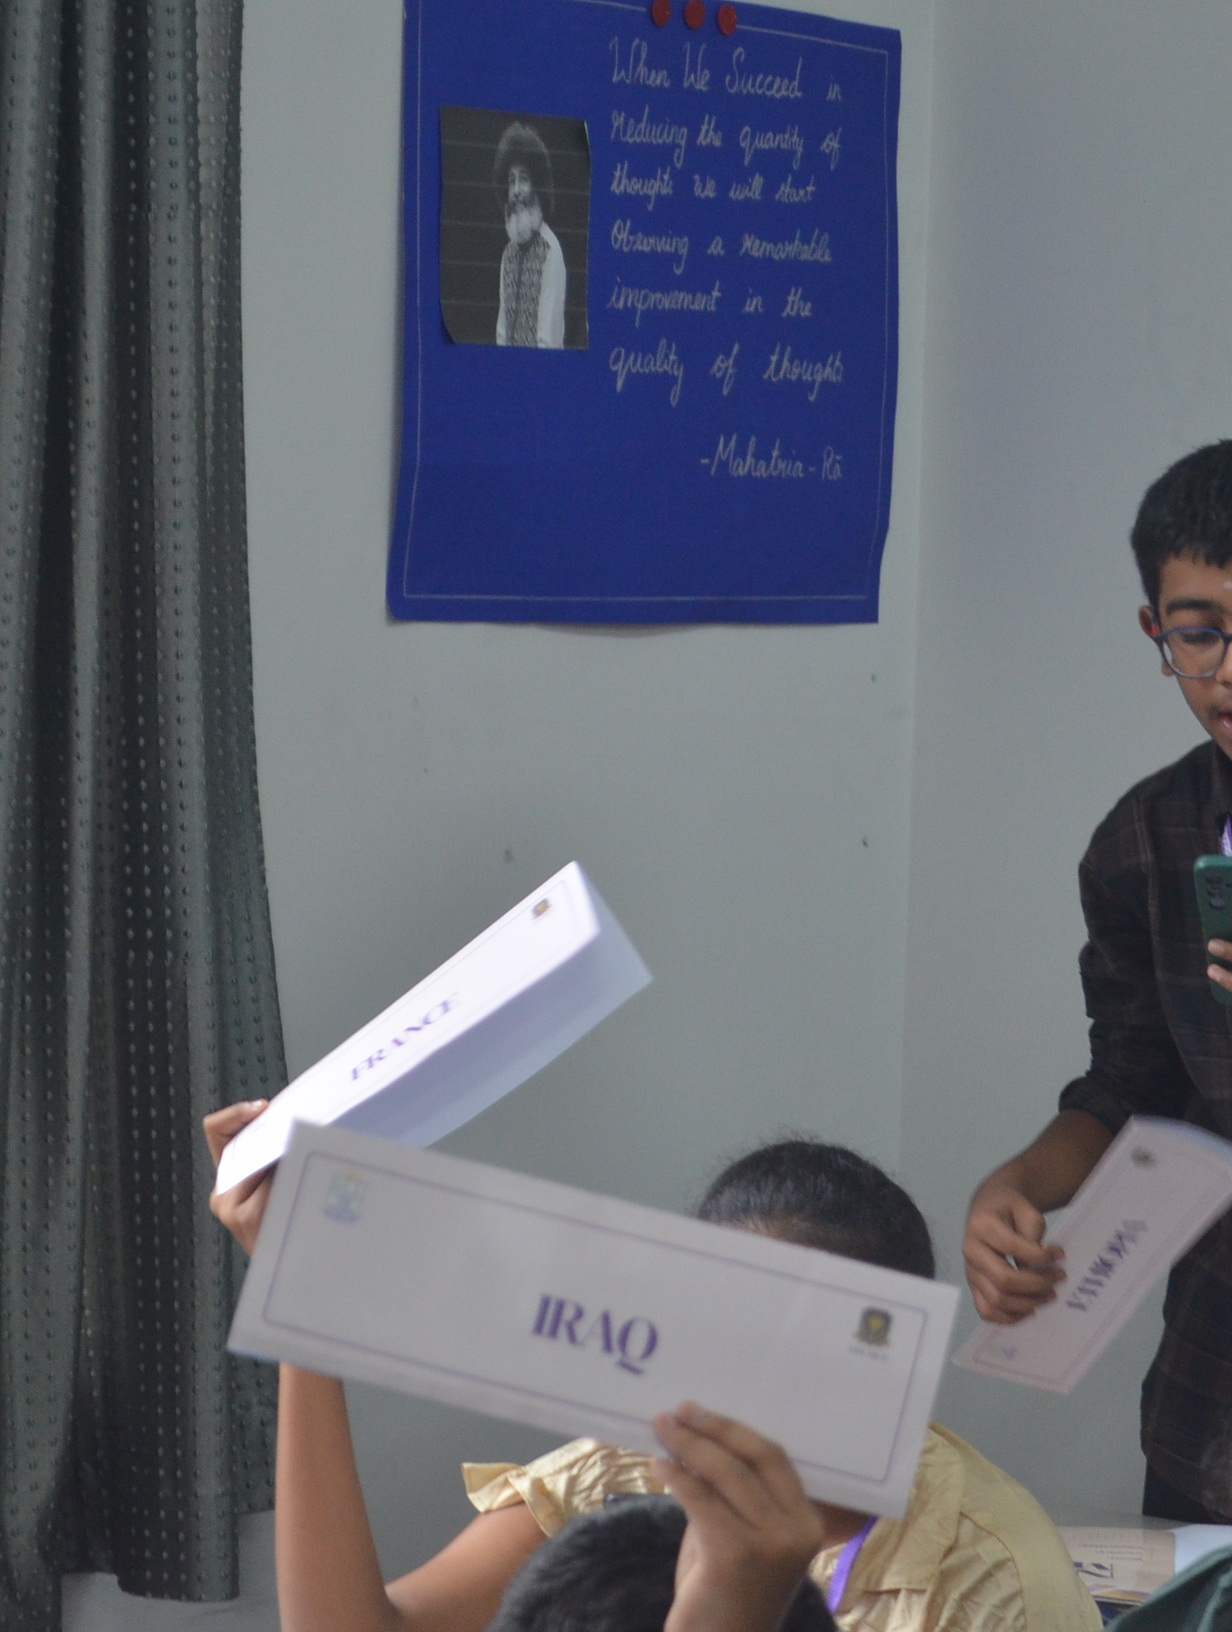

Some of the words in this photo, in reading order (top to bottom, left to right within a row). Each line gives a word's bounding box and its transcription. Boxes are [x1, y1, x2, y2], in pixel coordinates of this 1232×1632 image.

[609, 36, 670, 87] When
[683, 42, 711, 91] We
[726, 47, 802, 98] Succeed
[826, 74, 842, 100] in
[697, 113, 722, 147] the
[739, 124, 803, 170] quantity
[821, 125, 842, 171] of
[729, 172, 763, 200] will
[775, 174, 816, 203] start
[708, 236, 725, 256] a
[608, 275, 721, 328] improvement
[743, 287, 763, 314] in
[782, 286, 812, 318] the
[609, 338, 684, 407] quality
[710, 341, 739, 396] of
[764, 342, 843, 402] thoughts
[351, 990, 463, 1082] FRANCE
[531, 1293, 658, 1376] IRAQ
